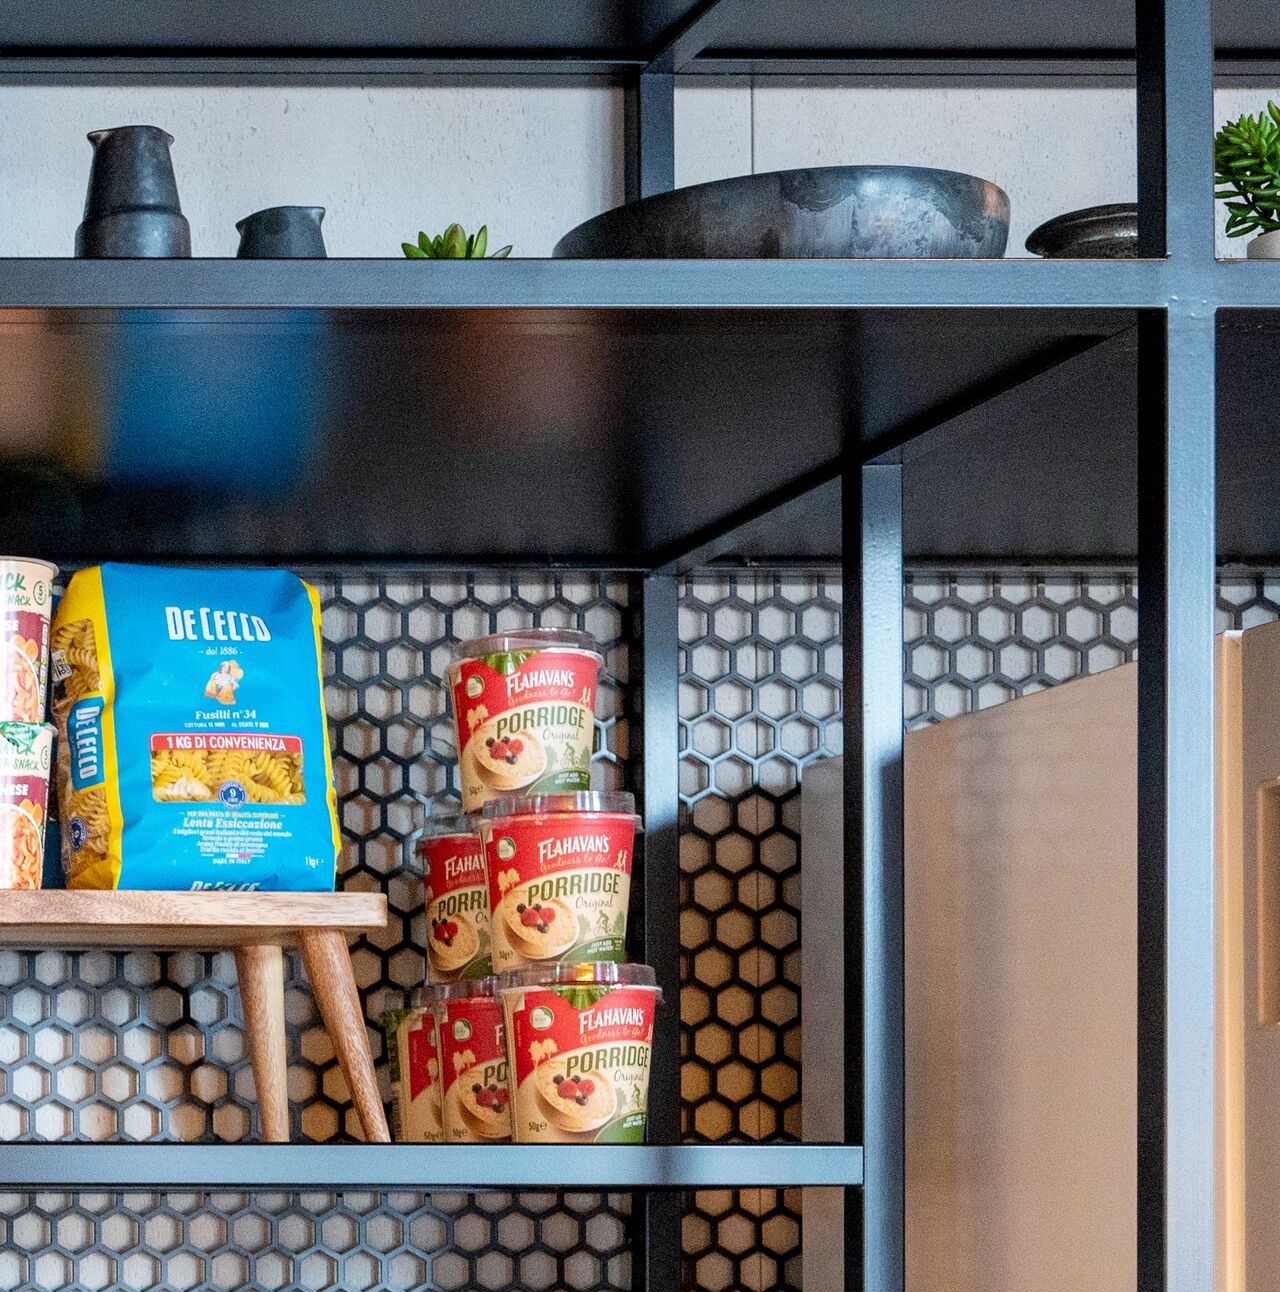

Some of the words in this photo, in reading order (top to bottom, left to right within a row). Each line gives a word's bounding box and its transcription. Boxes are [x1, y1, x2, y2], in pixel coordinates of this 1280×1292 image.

[506, 669, 576, 697] FLAHAVAN'S
[195, 711, 230, 720] Fusilli
[496, 705, 586, 739] PORRIDGE
[167, 737, 173, 749] 1
[176, 736, 192, 749] KG
[194, 737, 207, 749] DI
[210, 737, 287, 751] CONVENIENZA
[543, 729, 580, 743] Original
[183, 818, 213, 829] Lenta
[216, 819, 283, 830] Essiccazione
[538, 835, 610, 864] FLAHAVAN'S
[528, 873, 621, 901] PORRIDGE
[575, 895, 614, 915] Original
[578, 1007, 644, 1034] FLAHAVAN'S
[566, 1046, 649, 1078] PORRIDGE
